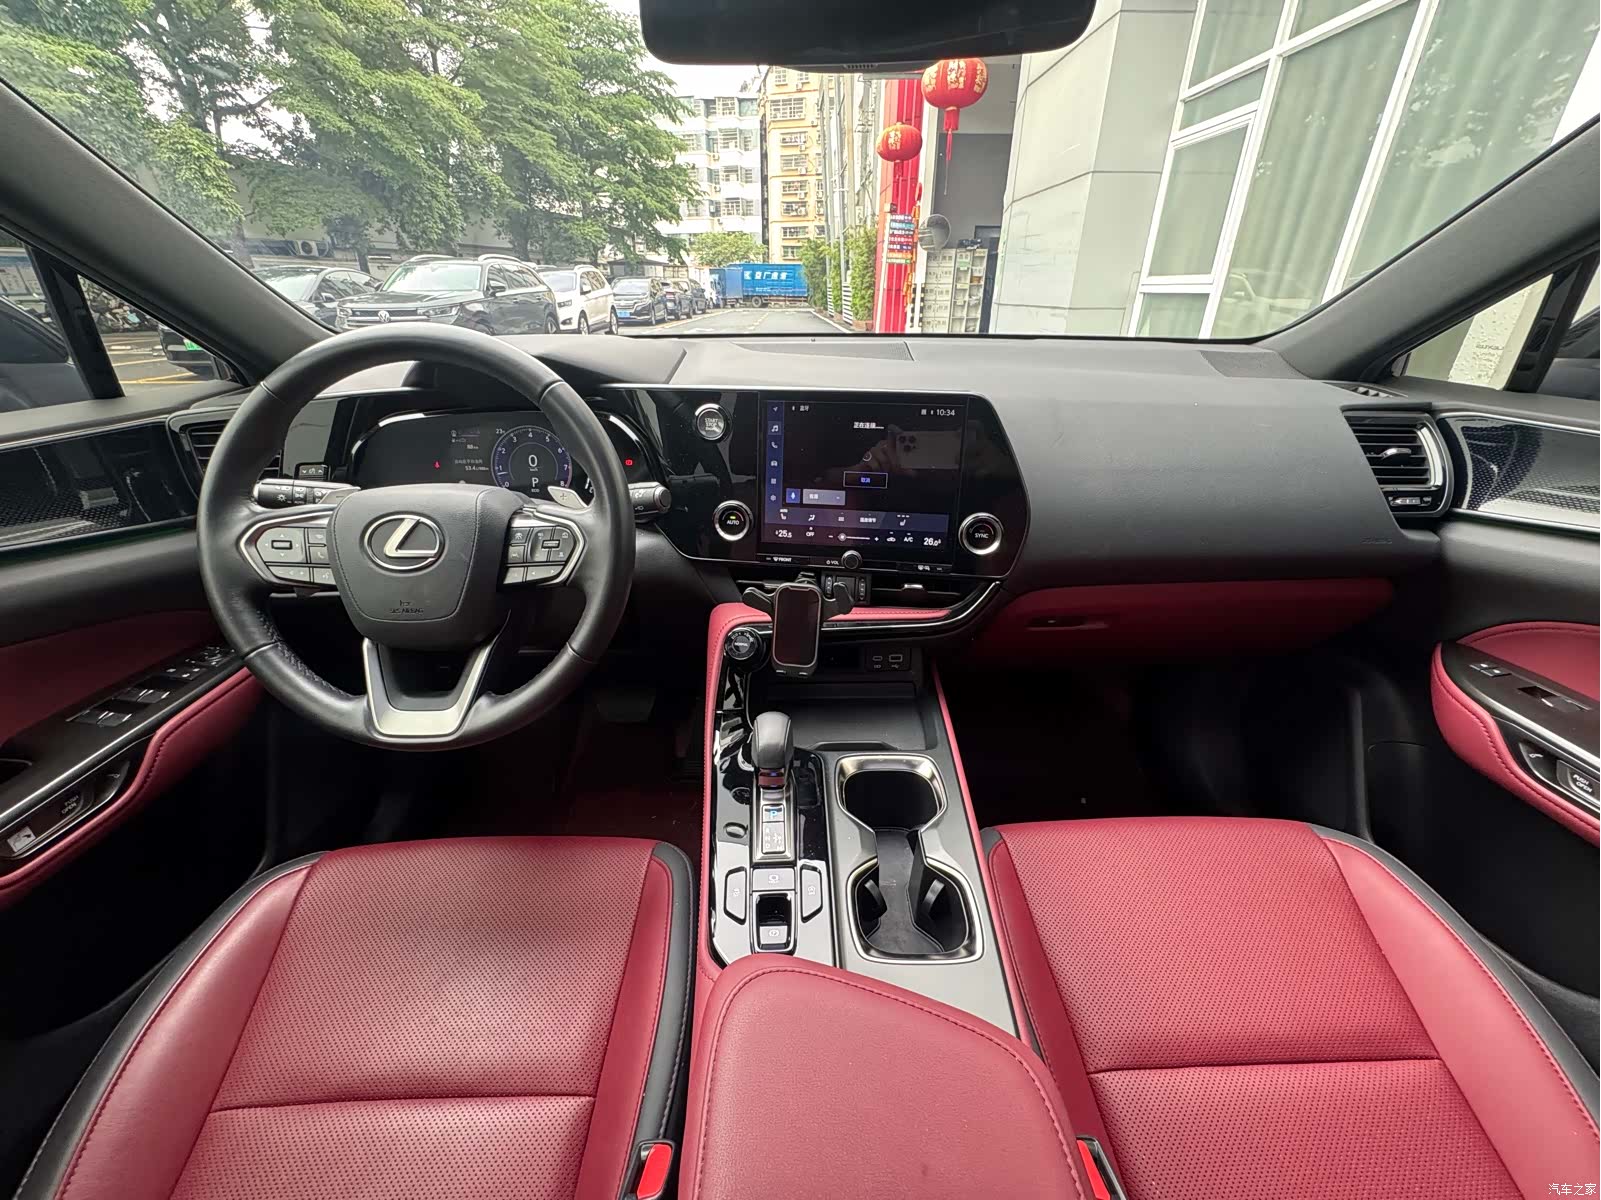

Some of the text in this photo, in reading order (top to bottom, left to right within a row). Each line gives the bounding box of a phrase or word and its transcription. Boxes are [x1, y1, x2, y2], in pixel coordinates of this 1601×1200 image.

[936, 408, 955, 417] 10:34
[528, 454, 538, 467] 0
[531, 477, 539, 488] P
[1573, 774, 1590, 785] PUSH
[1576, 781, 1593, 793] OPEN
[61, 802, 77, 814] OPEN
